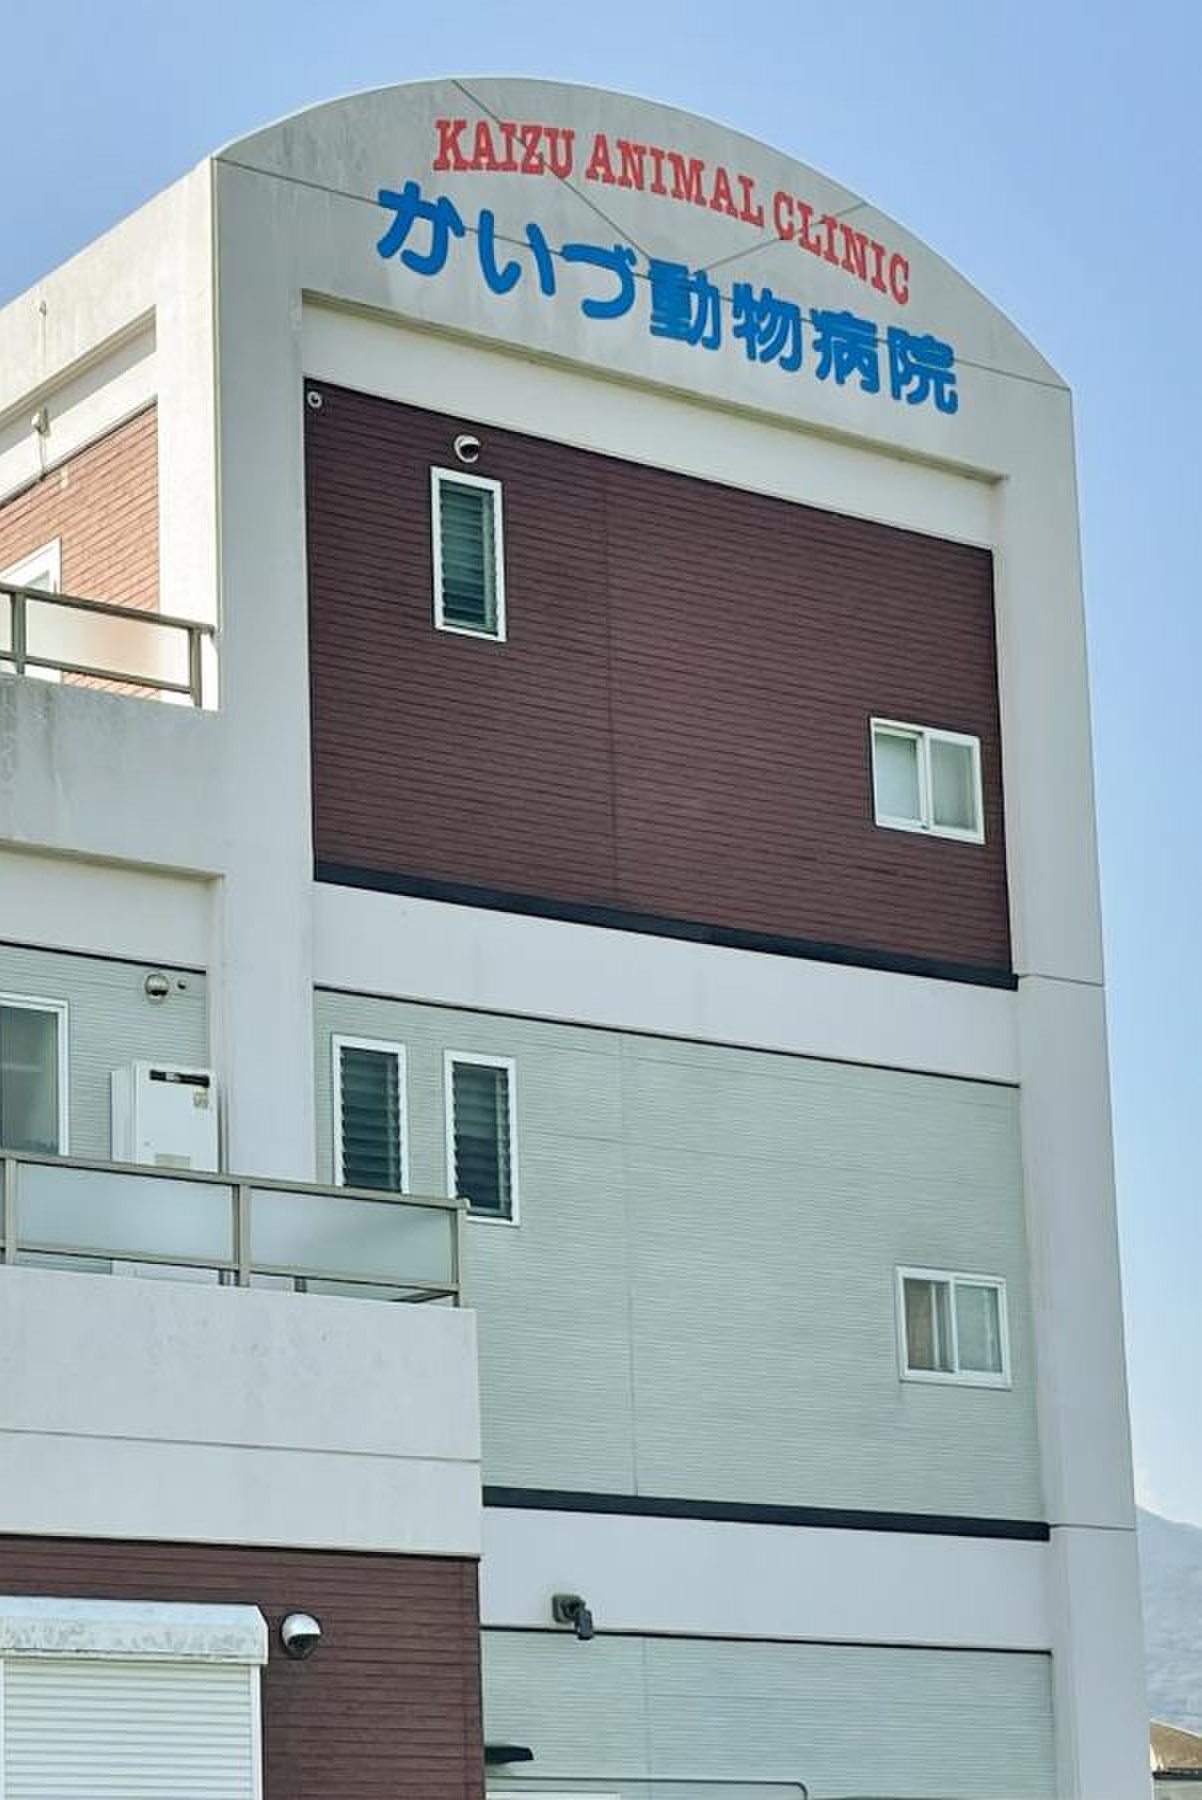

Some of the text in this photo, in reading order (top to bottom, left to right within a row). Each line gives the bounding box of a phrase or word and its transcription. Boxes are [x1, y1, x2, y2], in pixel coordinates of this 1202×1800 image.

[377, 181, 958, 414] かいづ動物病院
[433, 119, 910, 304] KAIZU ANIMAL CLINIC
